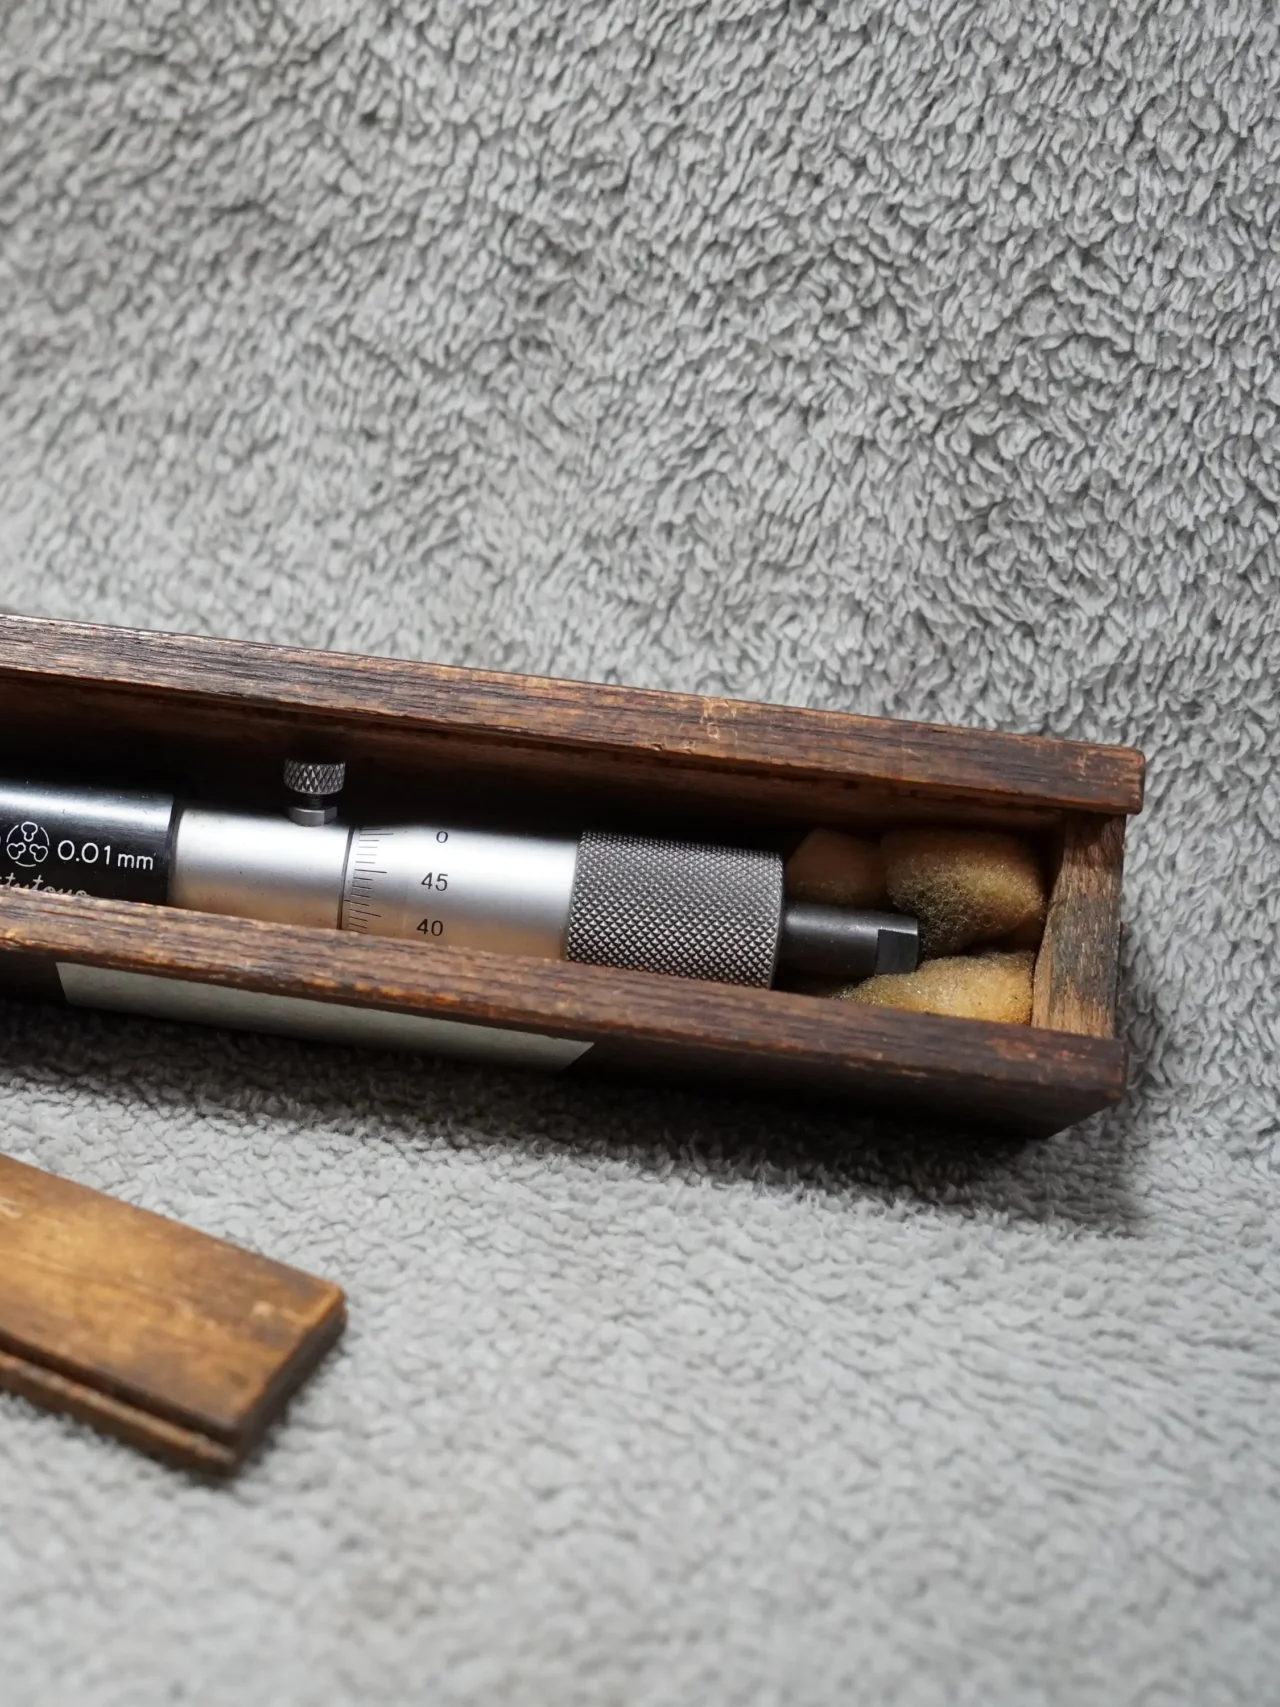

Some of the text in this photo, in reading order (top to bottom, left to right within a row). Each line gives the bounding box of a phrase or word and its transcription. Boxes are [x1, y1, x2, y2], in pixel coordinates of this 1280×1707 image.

[436, 831, 449, 843] 0
[421, 872, 448, 891] 45
[416, 918, 444, 936] 40
